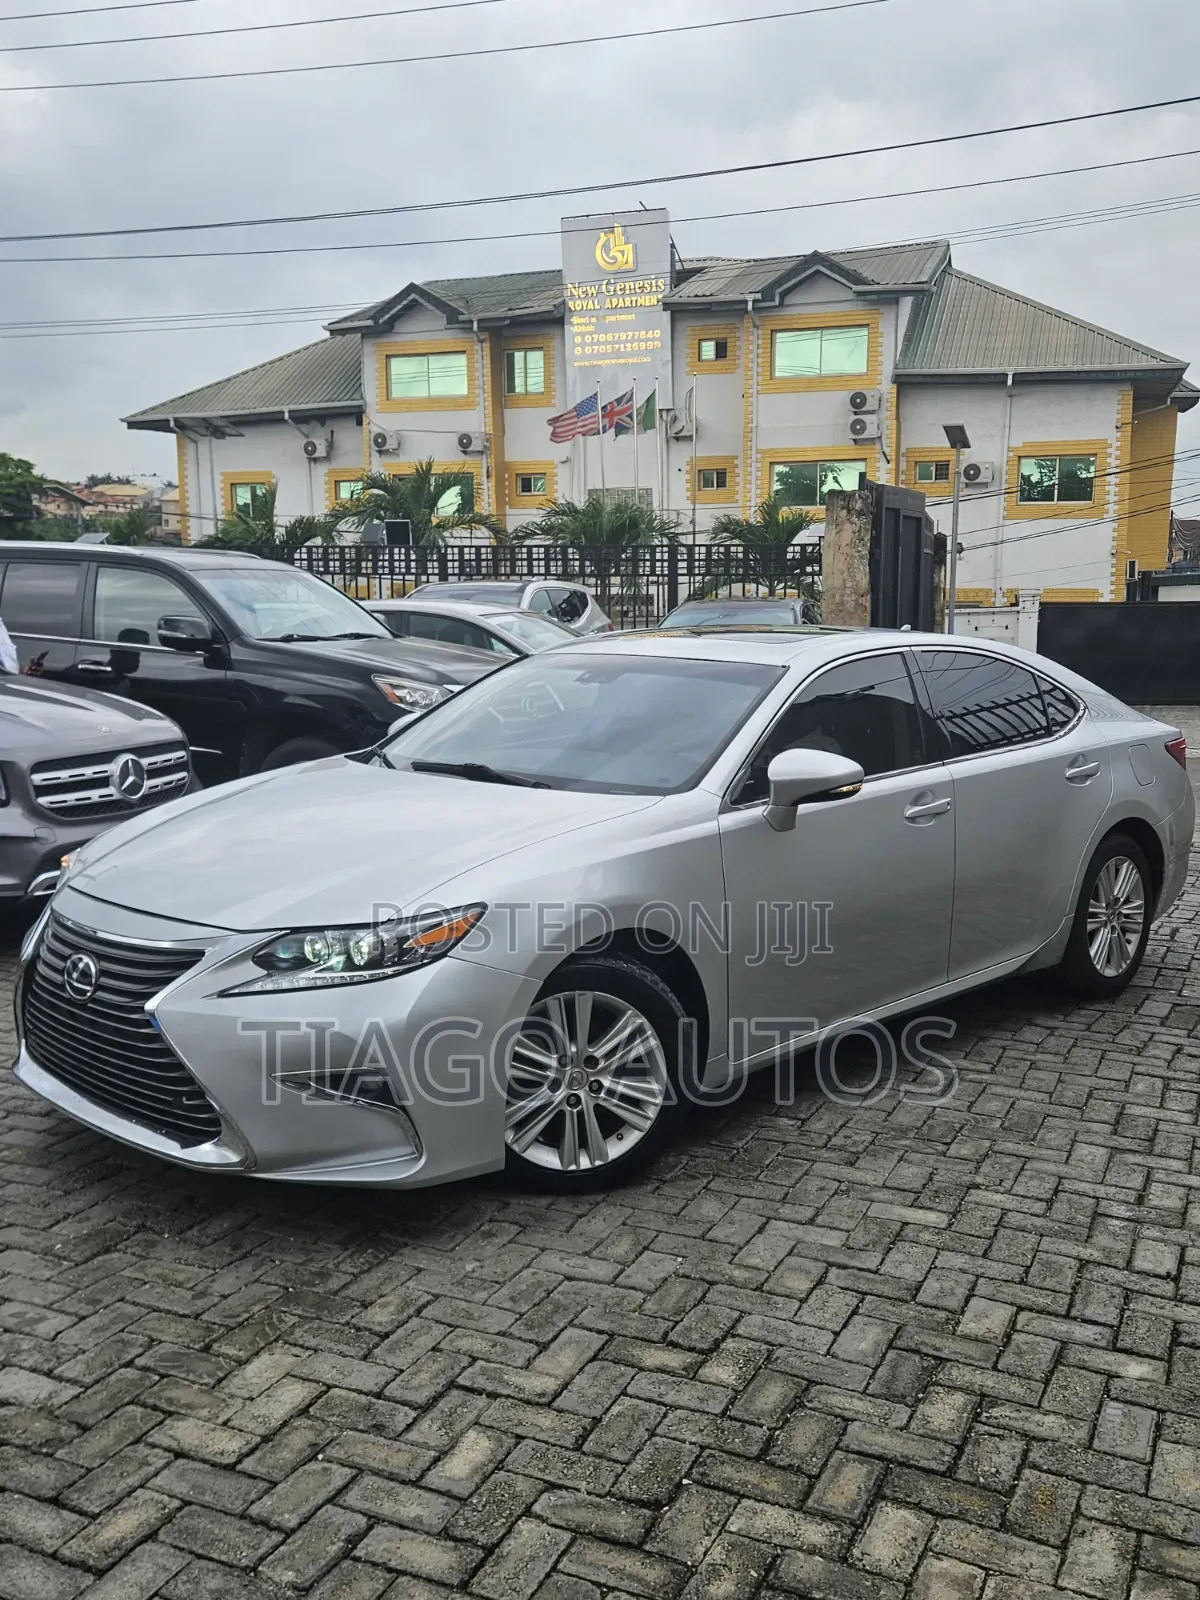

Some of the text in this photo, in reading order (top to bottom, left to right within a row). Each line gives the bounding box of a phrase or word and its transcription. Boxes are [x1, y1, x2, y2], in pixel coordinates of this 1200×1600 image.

[567, 275, 665, 299] New Genesis
[568, 300, 601, 312] ROYAL
[584, 329, 661, 343] 07067977840
